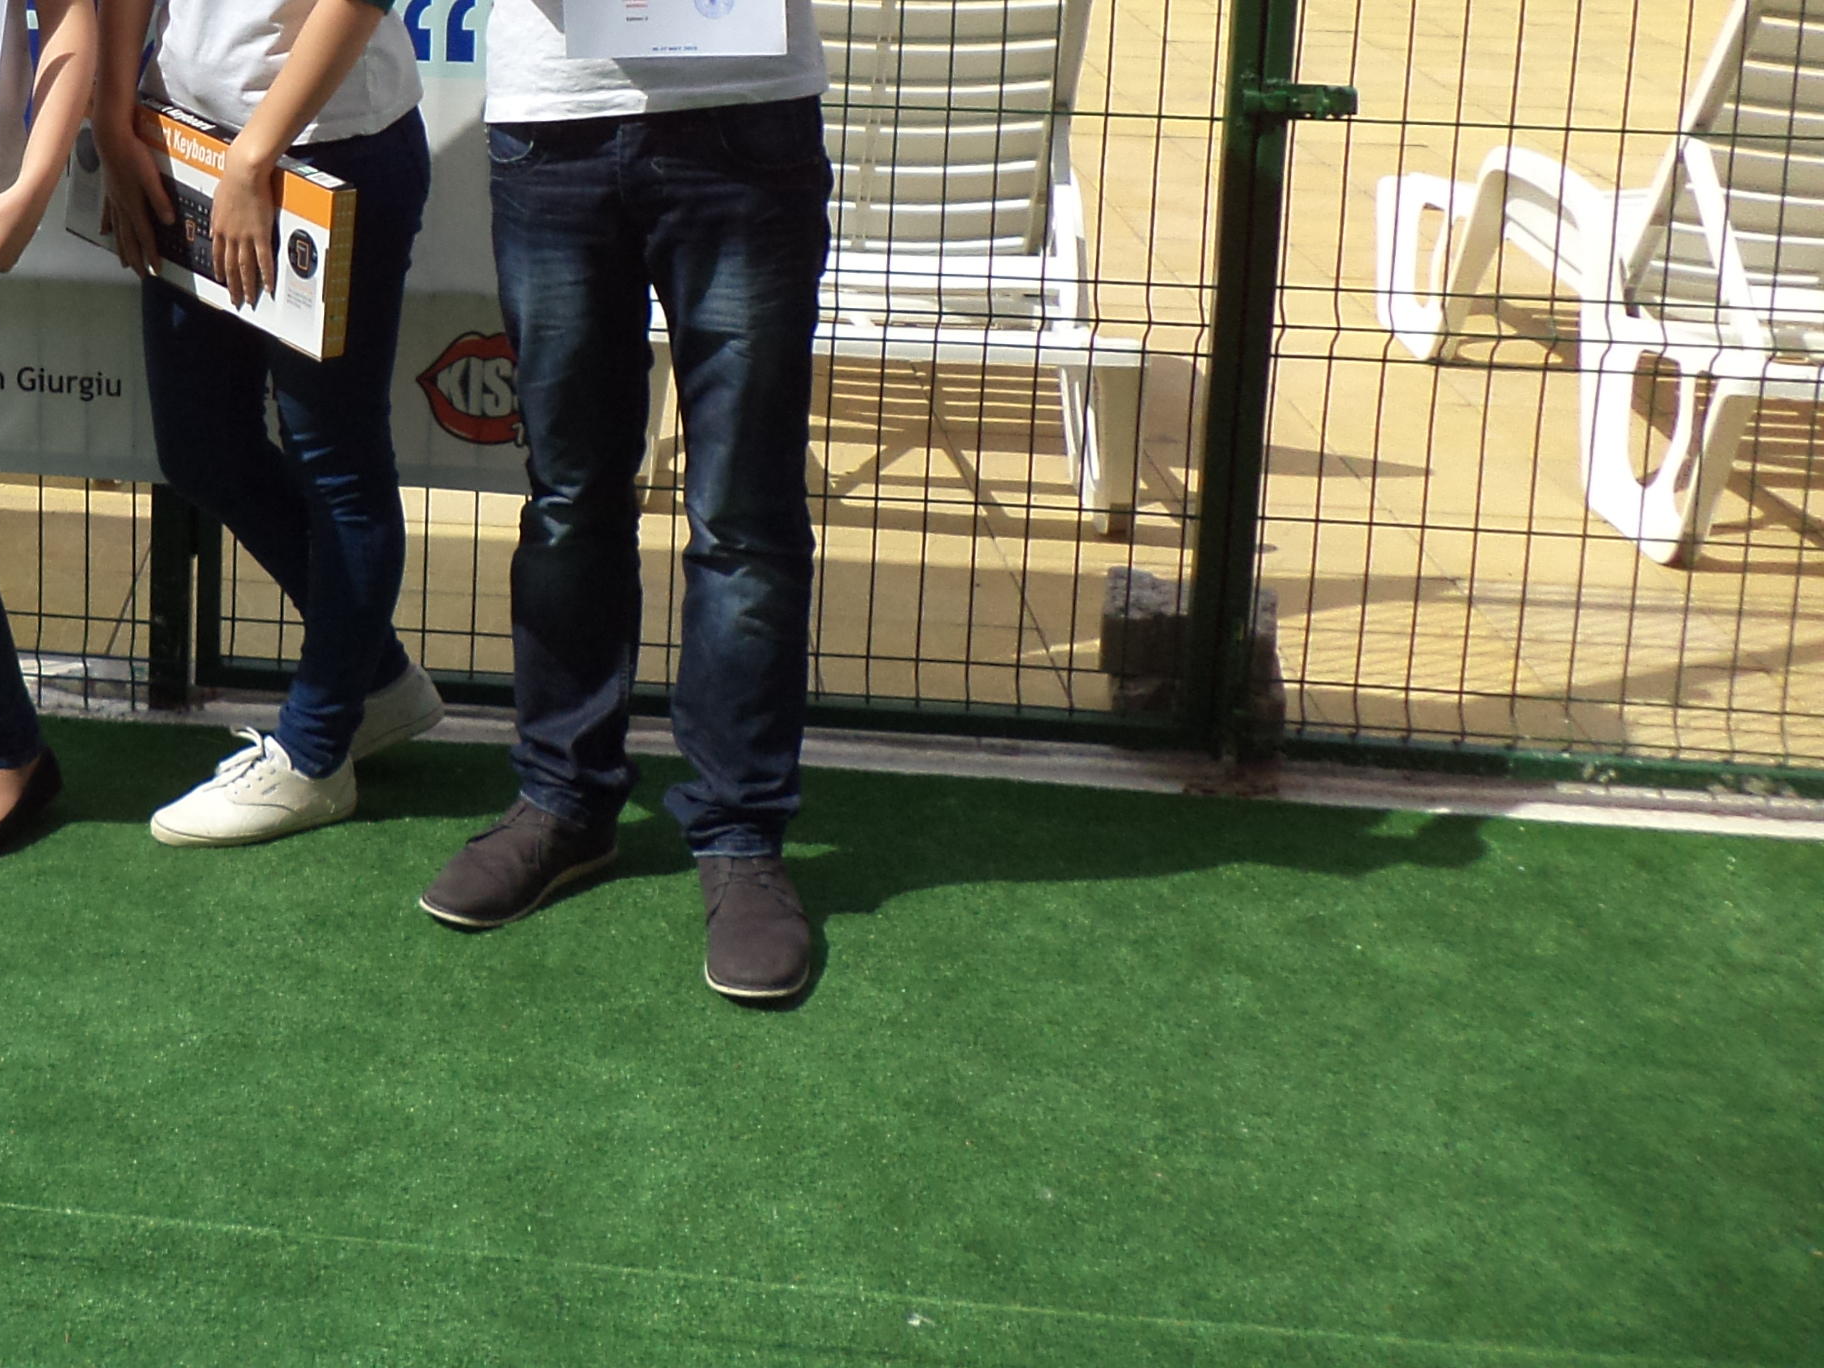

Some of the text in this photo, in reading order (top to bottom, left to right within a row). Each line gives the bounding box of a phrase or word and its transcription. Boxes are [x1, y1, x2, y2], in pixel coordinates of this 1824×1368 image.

[174, 128, 225, 171] Keyboard
[16, 366, 122, 402] Giurgiu
[437, 356, 518, 418] KIS
